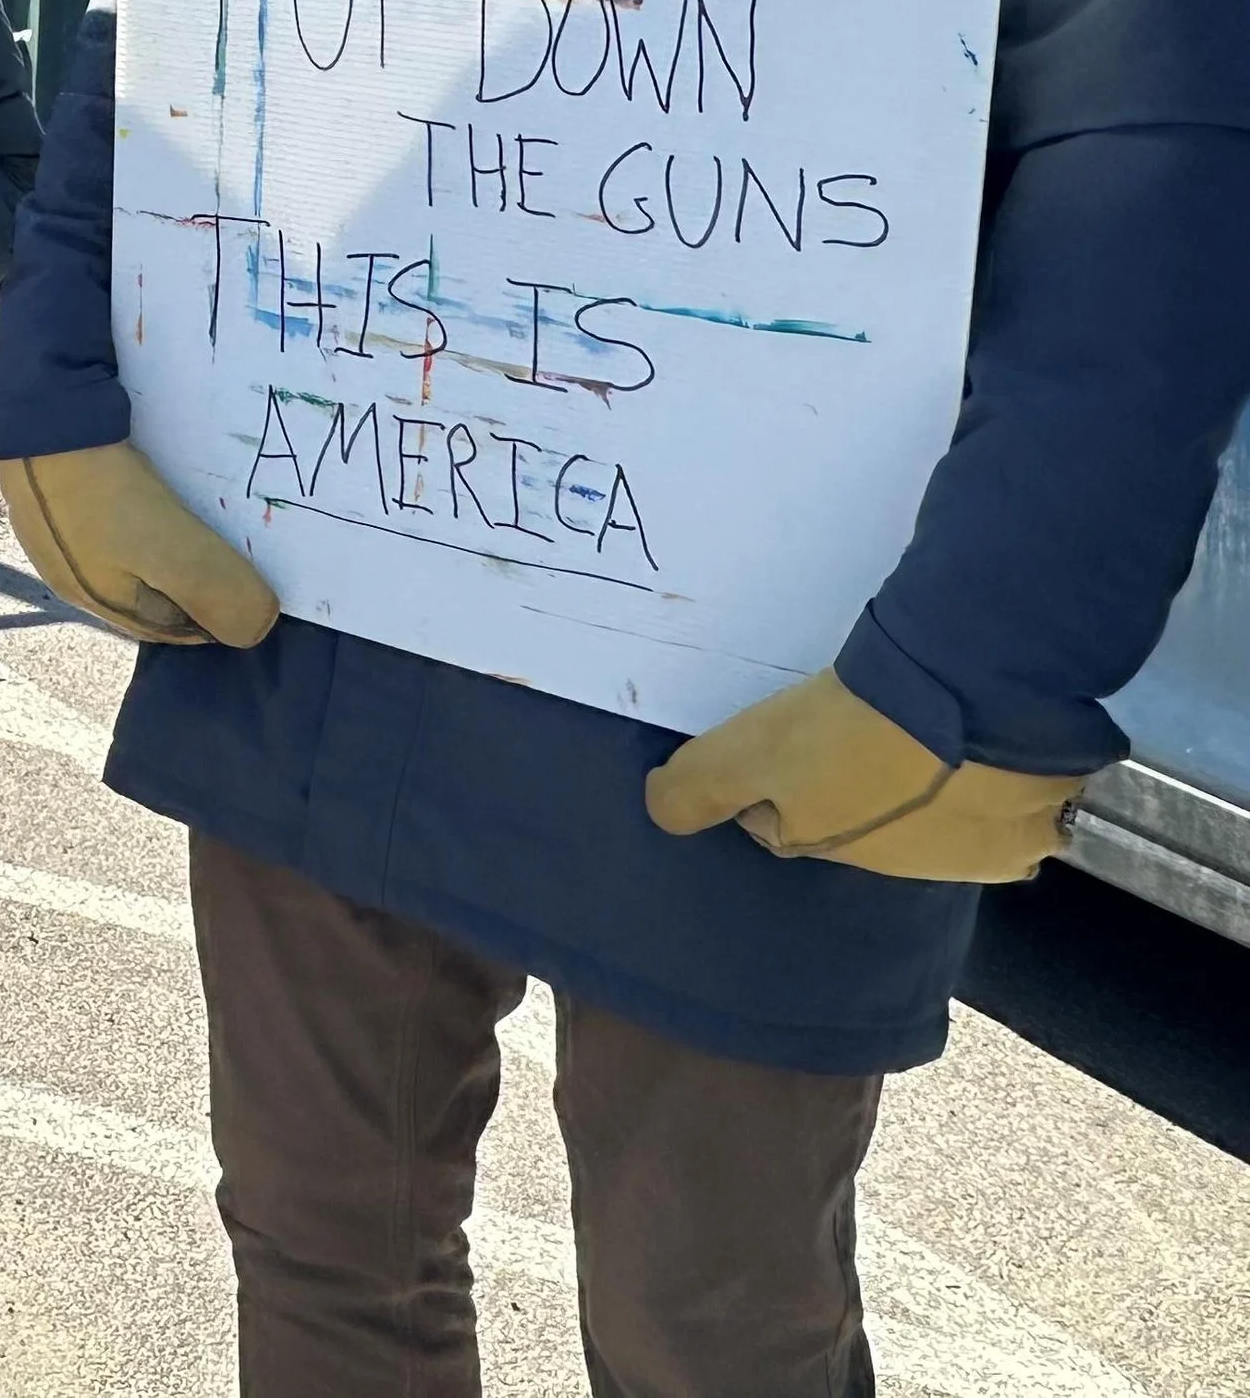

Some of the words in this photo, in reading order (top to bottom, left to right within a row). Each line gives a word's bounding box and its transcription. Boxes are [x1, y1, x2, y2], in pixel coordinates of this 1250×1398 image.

[397, 111, 558, 219] THE
[598, 142, 890, 252] GUNS
[190, 213, 447, 360] THIS
[505, 277, 655, 392] IS
[246, 383, 659, 572] AMERICA
